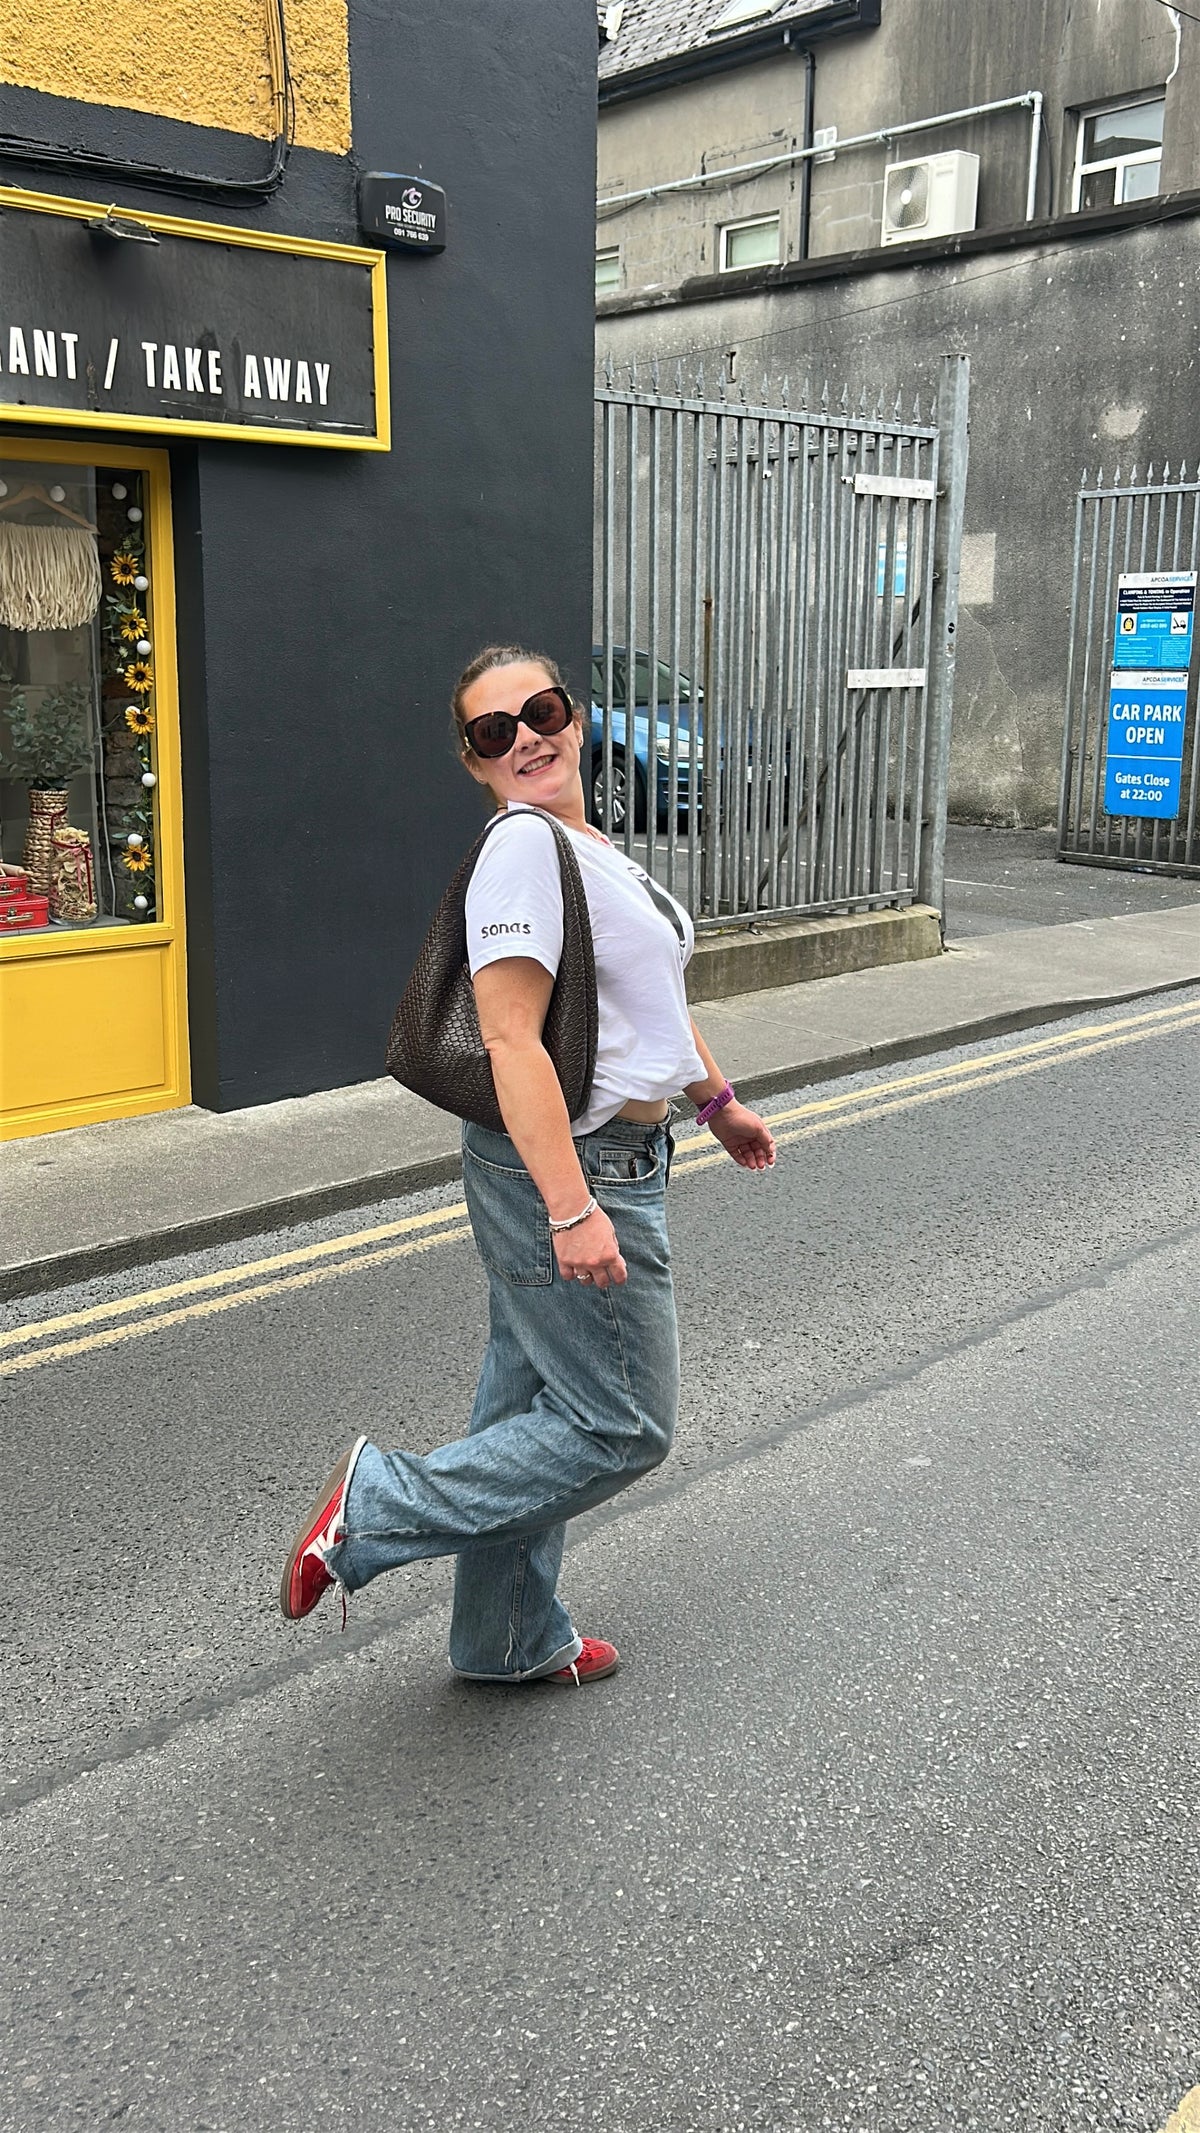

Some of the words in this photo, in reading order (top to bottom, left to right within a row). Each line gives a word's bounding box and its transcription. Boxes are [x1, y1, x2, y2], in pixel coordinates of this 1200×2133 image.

[385, 205, 401, 221] PRO
[402, 209, 436, 229] SECURITY
[394, 228, 405, 236] 091
[0, 326, 78, 380] ANT
[104, 338, 118, 390] /
[141, 342, 222, 394] TAKE
[244, 354, 330, 405] AWAY
[1113, 704, 1140, 720] CAR
[1144, 704, 1182, 722] PARK
[1126, 727, 1164, 744] OPEN
[1115, 772, 1141, 785] Gates
[1144, 774, 1170, 787] Close
[1120, 790, 1130, 799] at
[1132, 789, 1162, 801] 22:00
[481, 922, 531, 939] sonas
